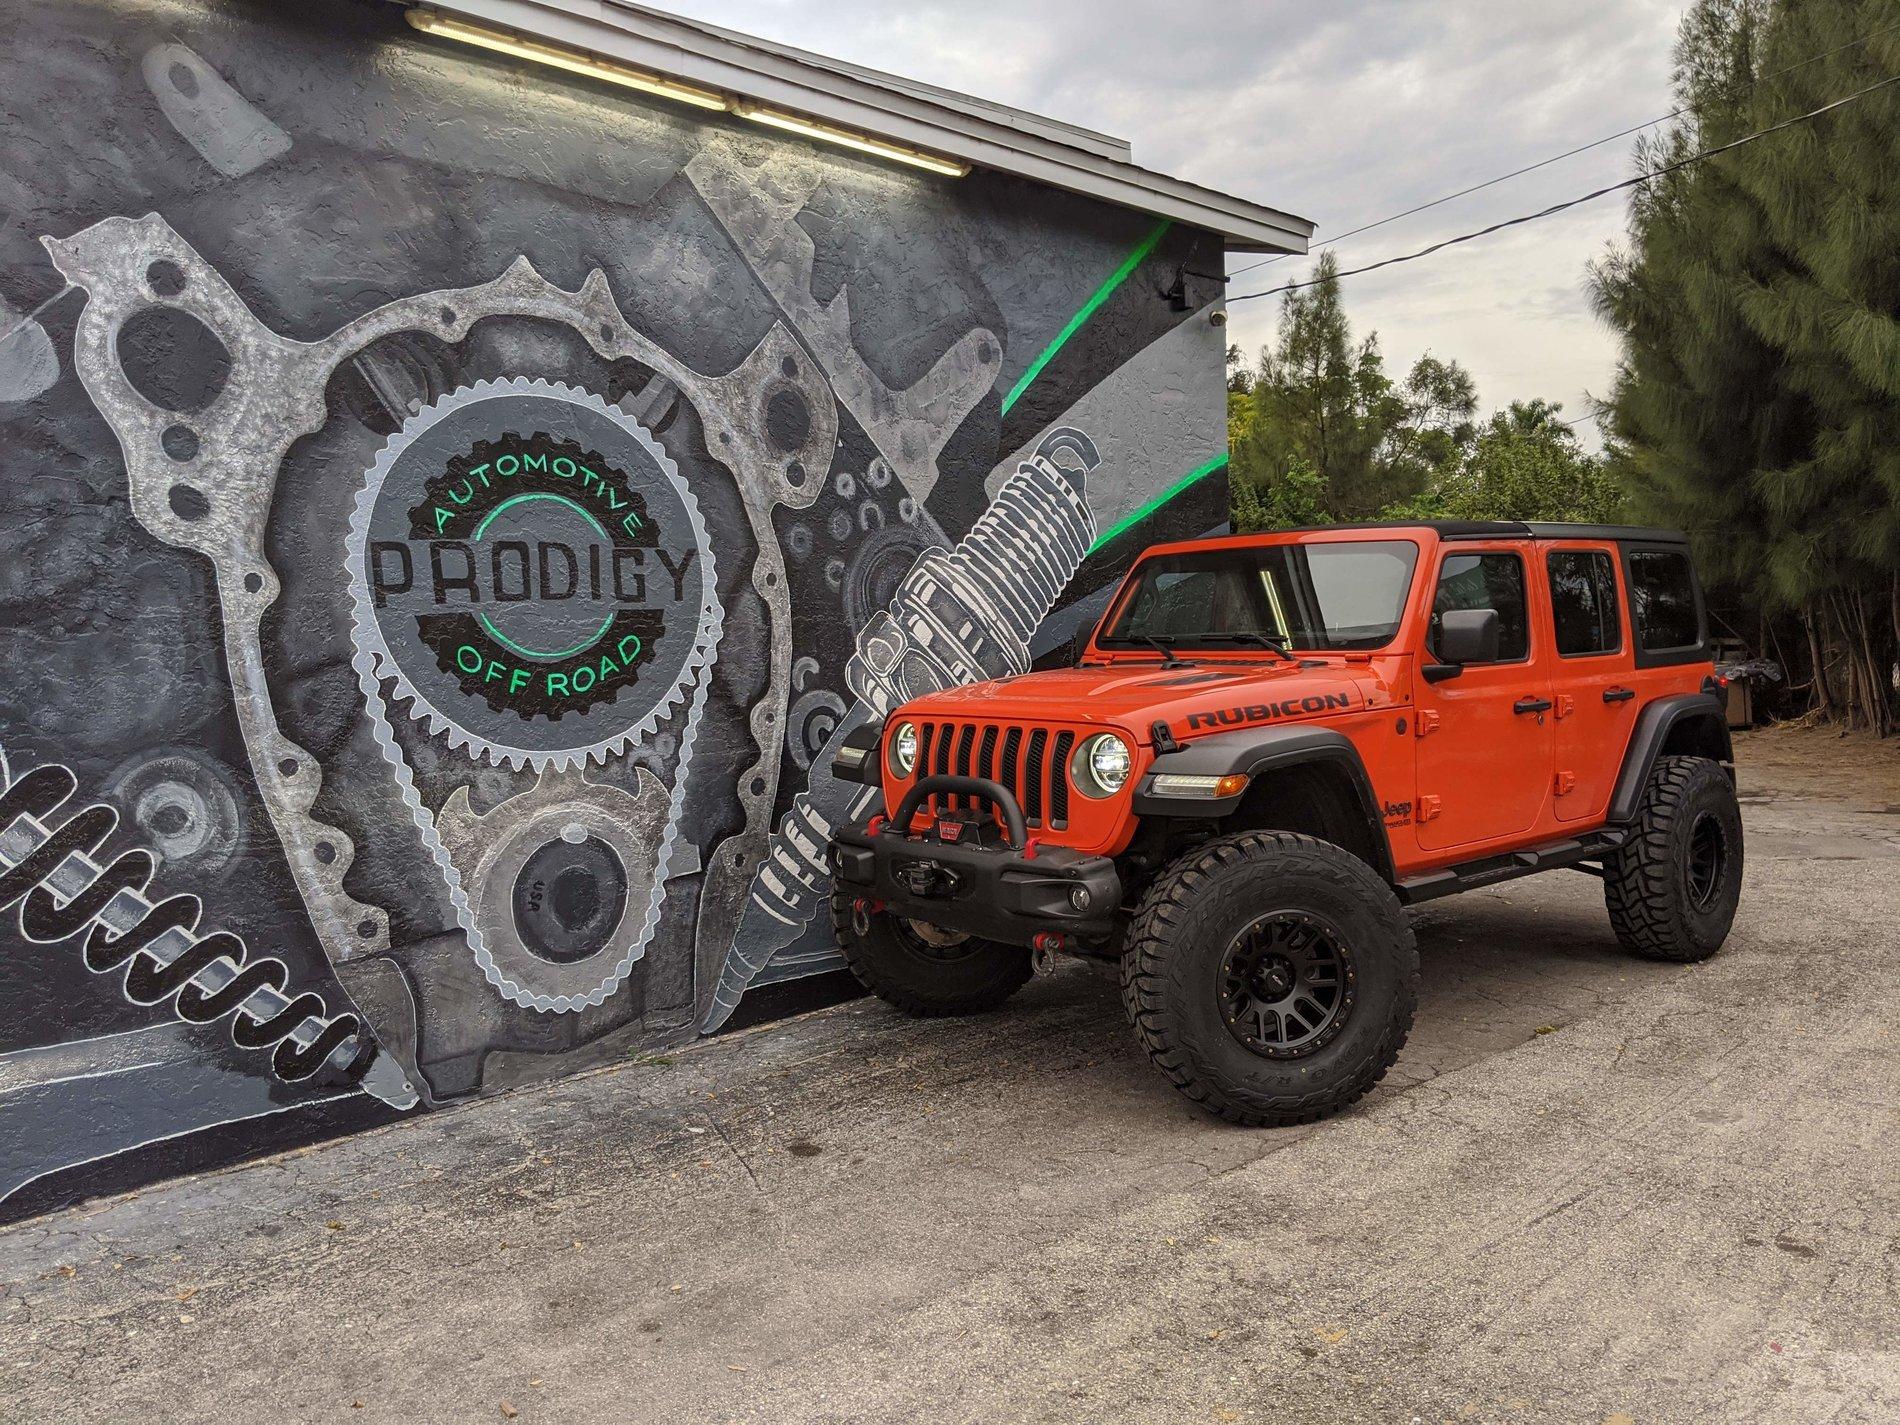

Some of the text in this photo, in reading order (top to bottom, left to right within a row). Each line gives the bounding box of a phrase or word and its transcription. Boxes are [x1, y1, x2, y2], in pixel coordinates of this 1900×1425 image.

[434, 453, 644, 538] AUTOMOTIVE
[370, 540, 699, 609] PRODIGY
[456, 635, 642, 696] OFF ROAD
[1187, 692, 1350, 730] RUBICON
[1381, 801, 1412, 818] Jeep
[527, 880, 545, 912] USA
